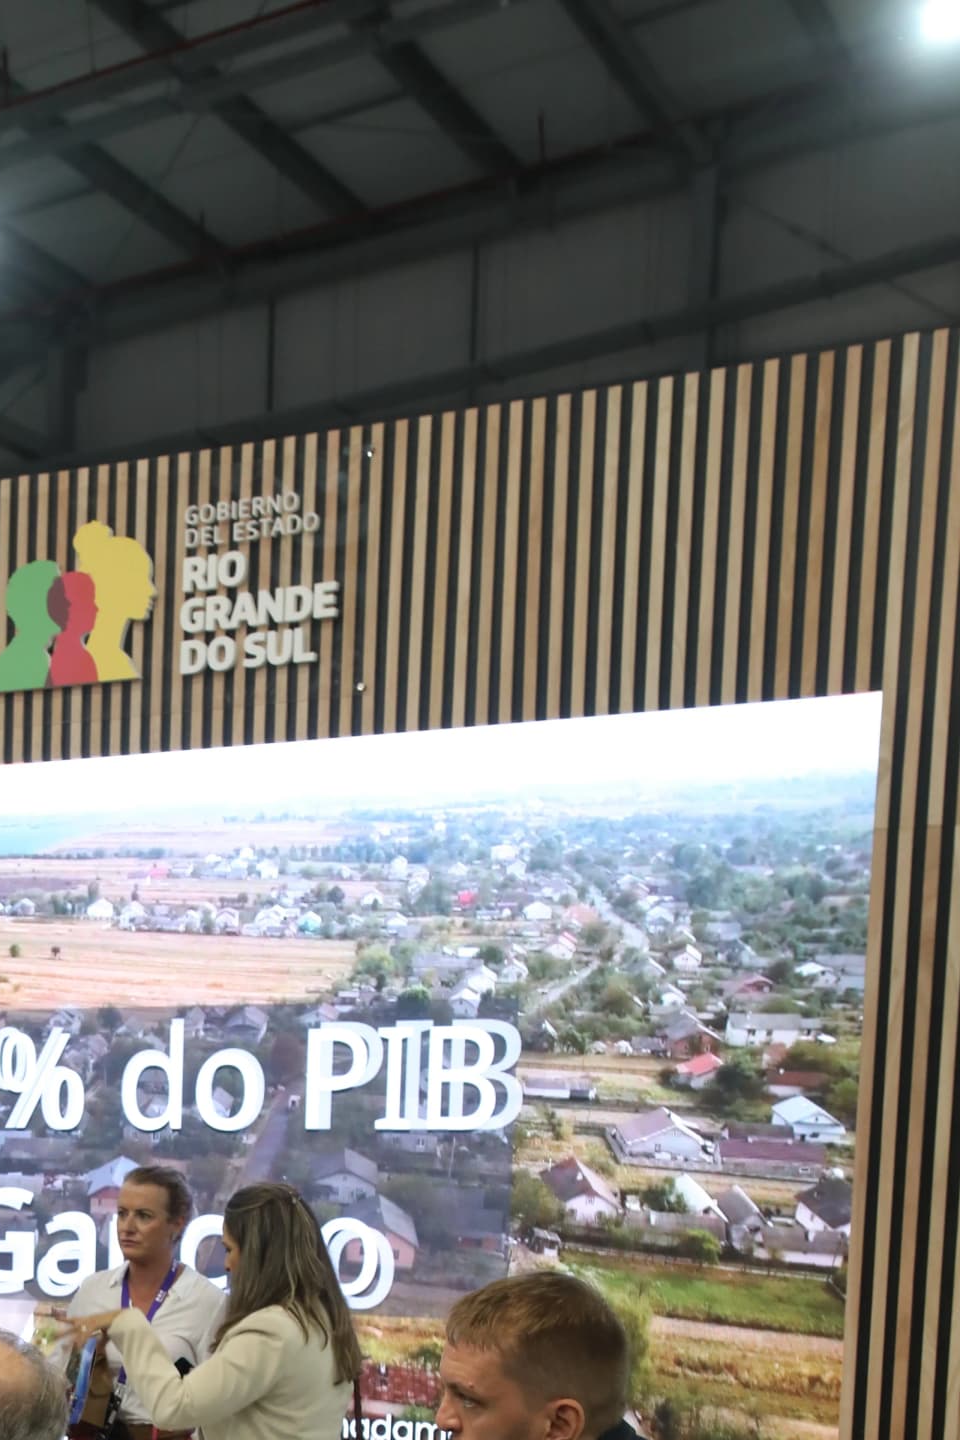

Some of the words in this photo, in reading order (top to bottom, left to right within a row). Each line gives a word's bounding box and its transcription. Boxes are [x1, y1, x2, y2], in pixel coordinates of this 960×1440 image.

[184, 490, 301, 527] GOBIERNO
[184, 526, 225, 549] DEL
[232, 511, 321, 543] ESTADO
[182, 550, 248, 593] RIO
[179, 580, 340, 634] GRANDE
[179, 636, 237, 675] DO
[242, 626, 318, 669] SUL
[120, 1018, 265, 1134] do
[304, 1018, 525, 1132] PIB
